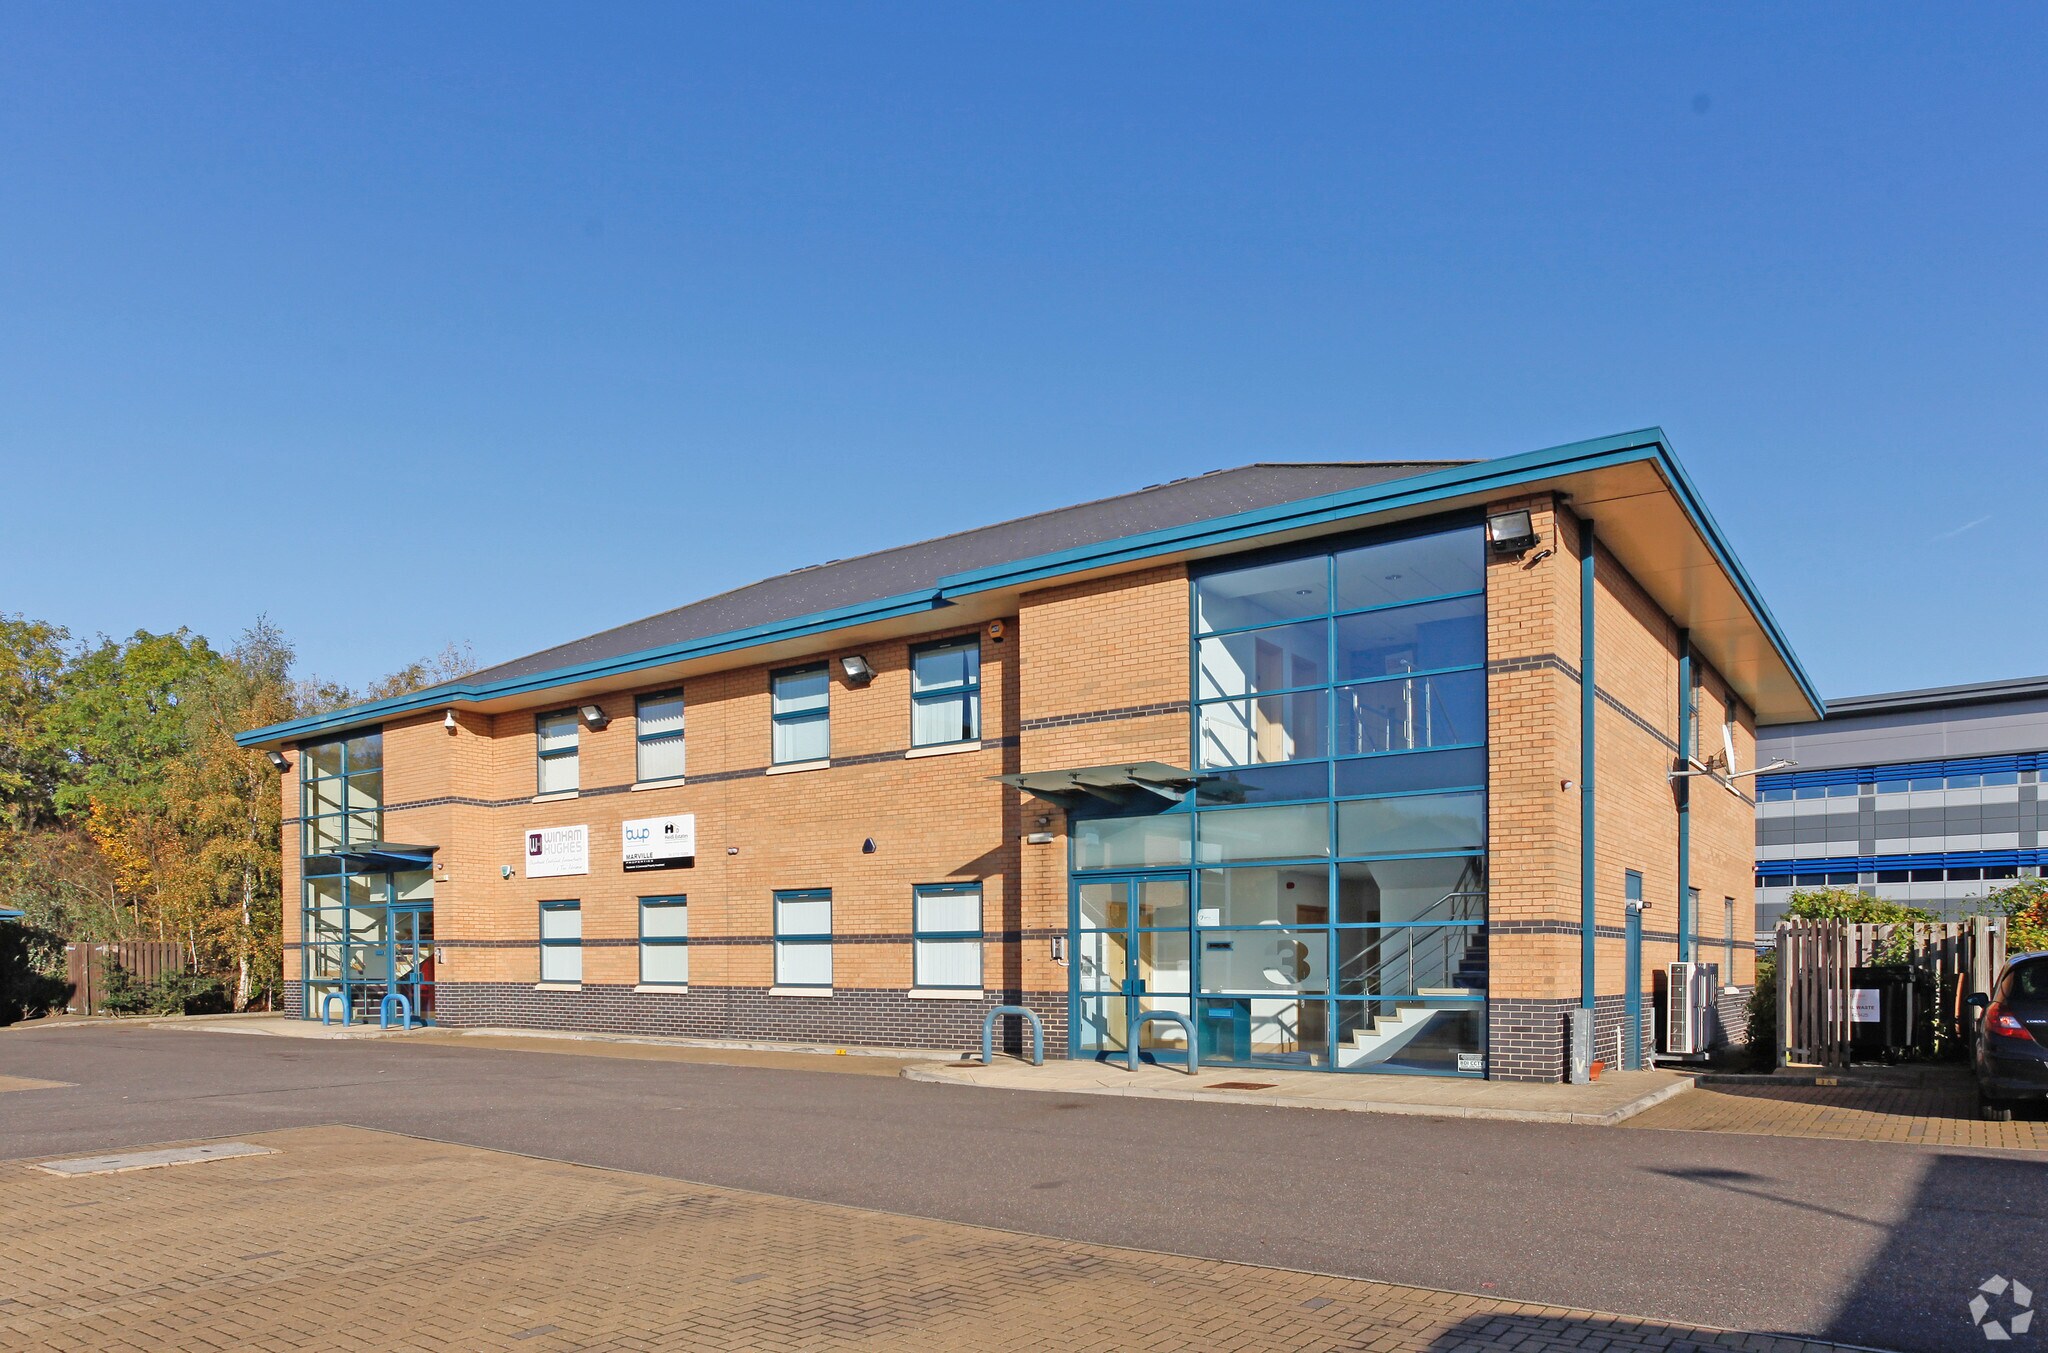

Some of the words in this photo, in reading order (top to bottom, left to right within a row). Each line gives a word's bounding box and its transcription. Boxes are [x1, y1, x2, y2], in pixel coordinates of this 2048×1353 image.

[544, 829, 582, 844] WINHAM
[544, 841, 582, 855] HUGHES
[626, 852, 653, 860] MARVILLE
